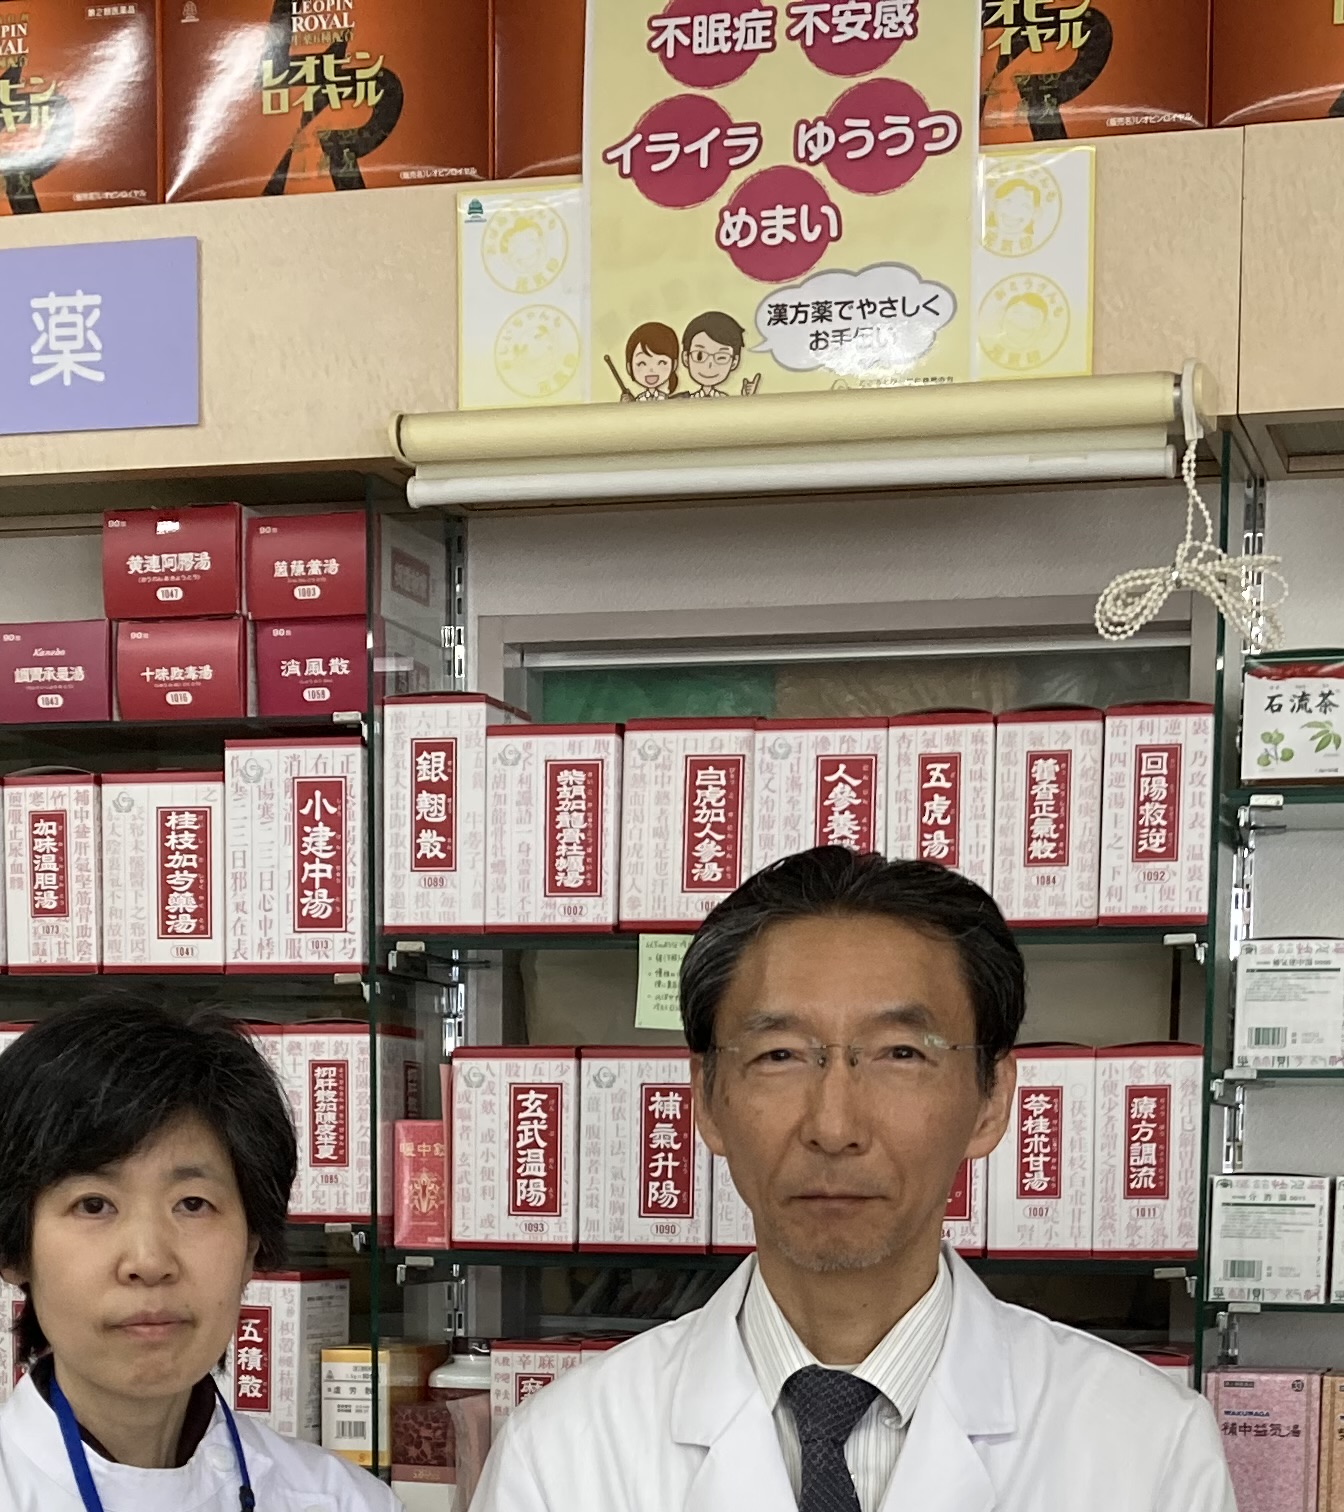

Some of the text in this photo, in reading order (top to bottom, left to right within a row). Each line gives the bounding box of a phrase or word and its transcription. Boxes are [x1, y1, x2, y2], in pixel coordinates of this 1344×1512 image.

[291, 12, 355, 32] ROYAL
[649, 10, 776, 59] 不眠症
[787, 0, 919, 45] 不安感
[261, 51, 384, 87] レオピン
[262, 80, 384, 115] ロイヤル
[604, 117, 762, 176] イライラ
[794, 109, 960, 163] ゆううつ
[717, 199, 842, 247] めまい
[766, 294, 942, 328] 漢方薬でやさしく
[281, 657, 351, 677] 消風散
[1264, 692, 1340, 714] 石流茶
[416, 750, 449, 861] 銀翹散
[921, 762, 954, 860] 五虎湯
[1137, 752, 1169, 854] 回陽救逆
[33, 820, 60, 910] 加味温胆湯
[300, 790, 338, 920] 小建中湯
[562, 904, 584, 916] 1002
[516, 1089, 548, 1208] 玄武温陽
[523, 1222, 545, 1233] 1093
[1027, 1206, 1049, 1217] 1007
[237, 1319, 264, 1399] 五積散
